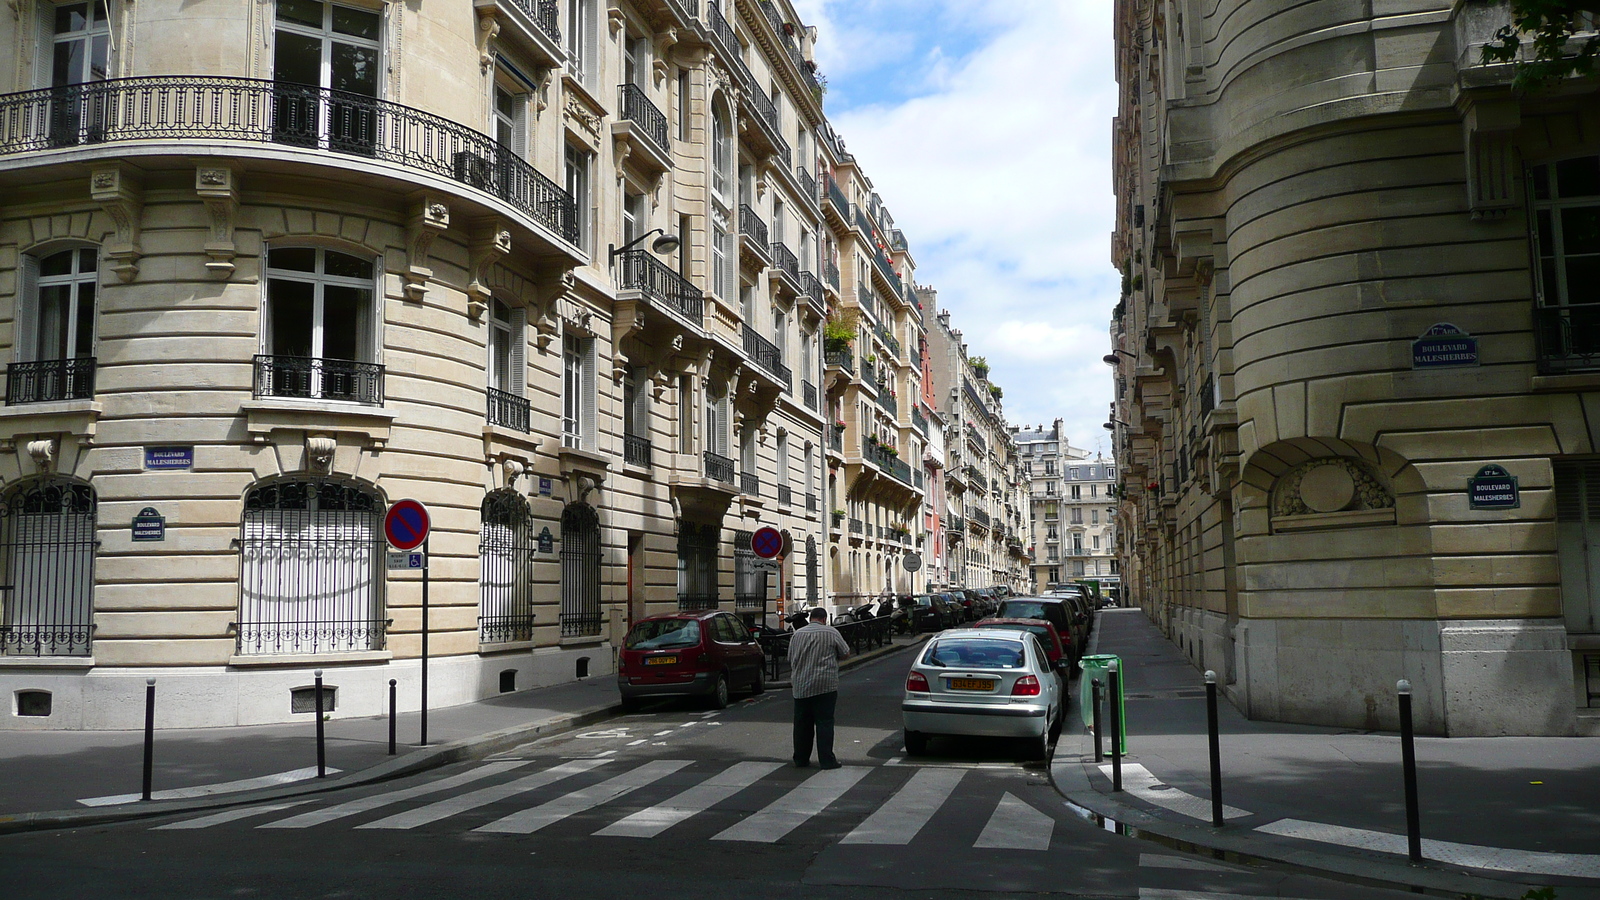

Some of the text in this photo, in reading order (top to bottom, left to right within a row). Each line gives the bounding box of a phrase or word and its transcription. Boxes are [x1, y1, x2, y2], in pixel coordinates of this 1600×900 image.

[1422, 343, 1467, 353] BOULEVARD
[1414, 352, 1477, 363] MALESHERBES
[147, 458, 190, 466] MALESHERBES
[1476, 483, 1511, 492] BOULEVARD
[1473, 494, 1514, 502] MALESHERBES
